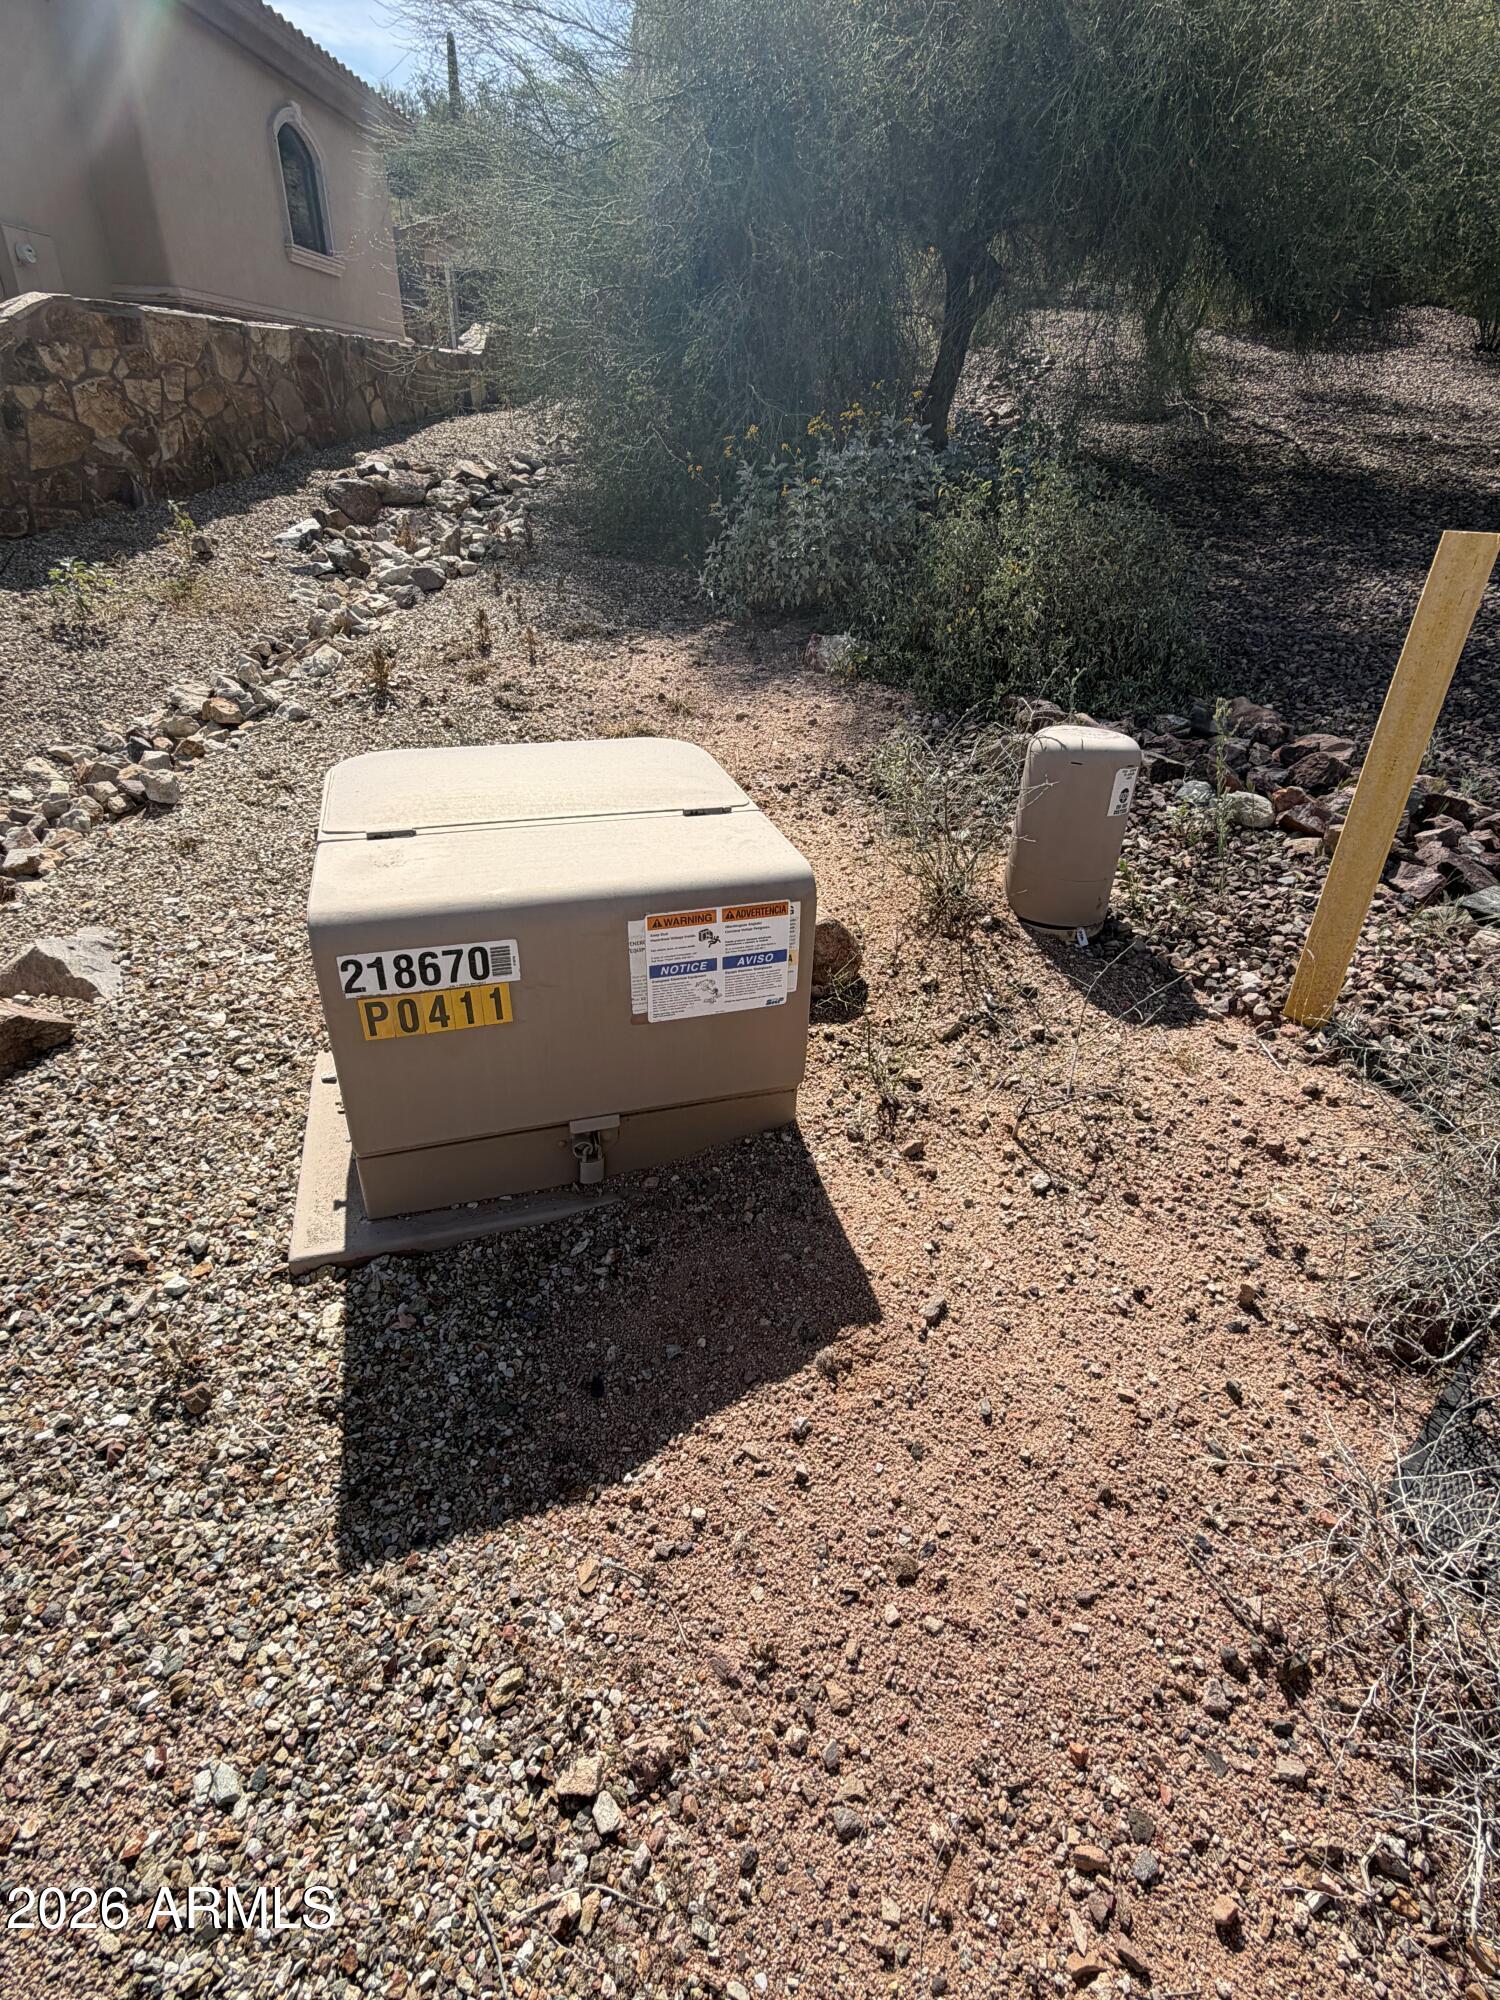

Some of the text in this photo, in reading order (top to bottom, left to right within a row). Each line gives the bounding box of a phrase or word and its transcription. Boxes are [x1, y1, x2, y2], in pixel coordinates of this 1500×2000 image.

[736, 905, 786, 919] ADVERTENCIA
[663, 914, 712, 927] WARNING
[737, 953, 774, 967] AVISO
[340, 946, 490, 993] 218670
[660, 961, 708, 976] NOTICE
[364, 987, 503, 1036] P0411
